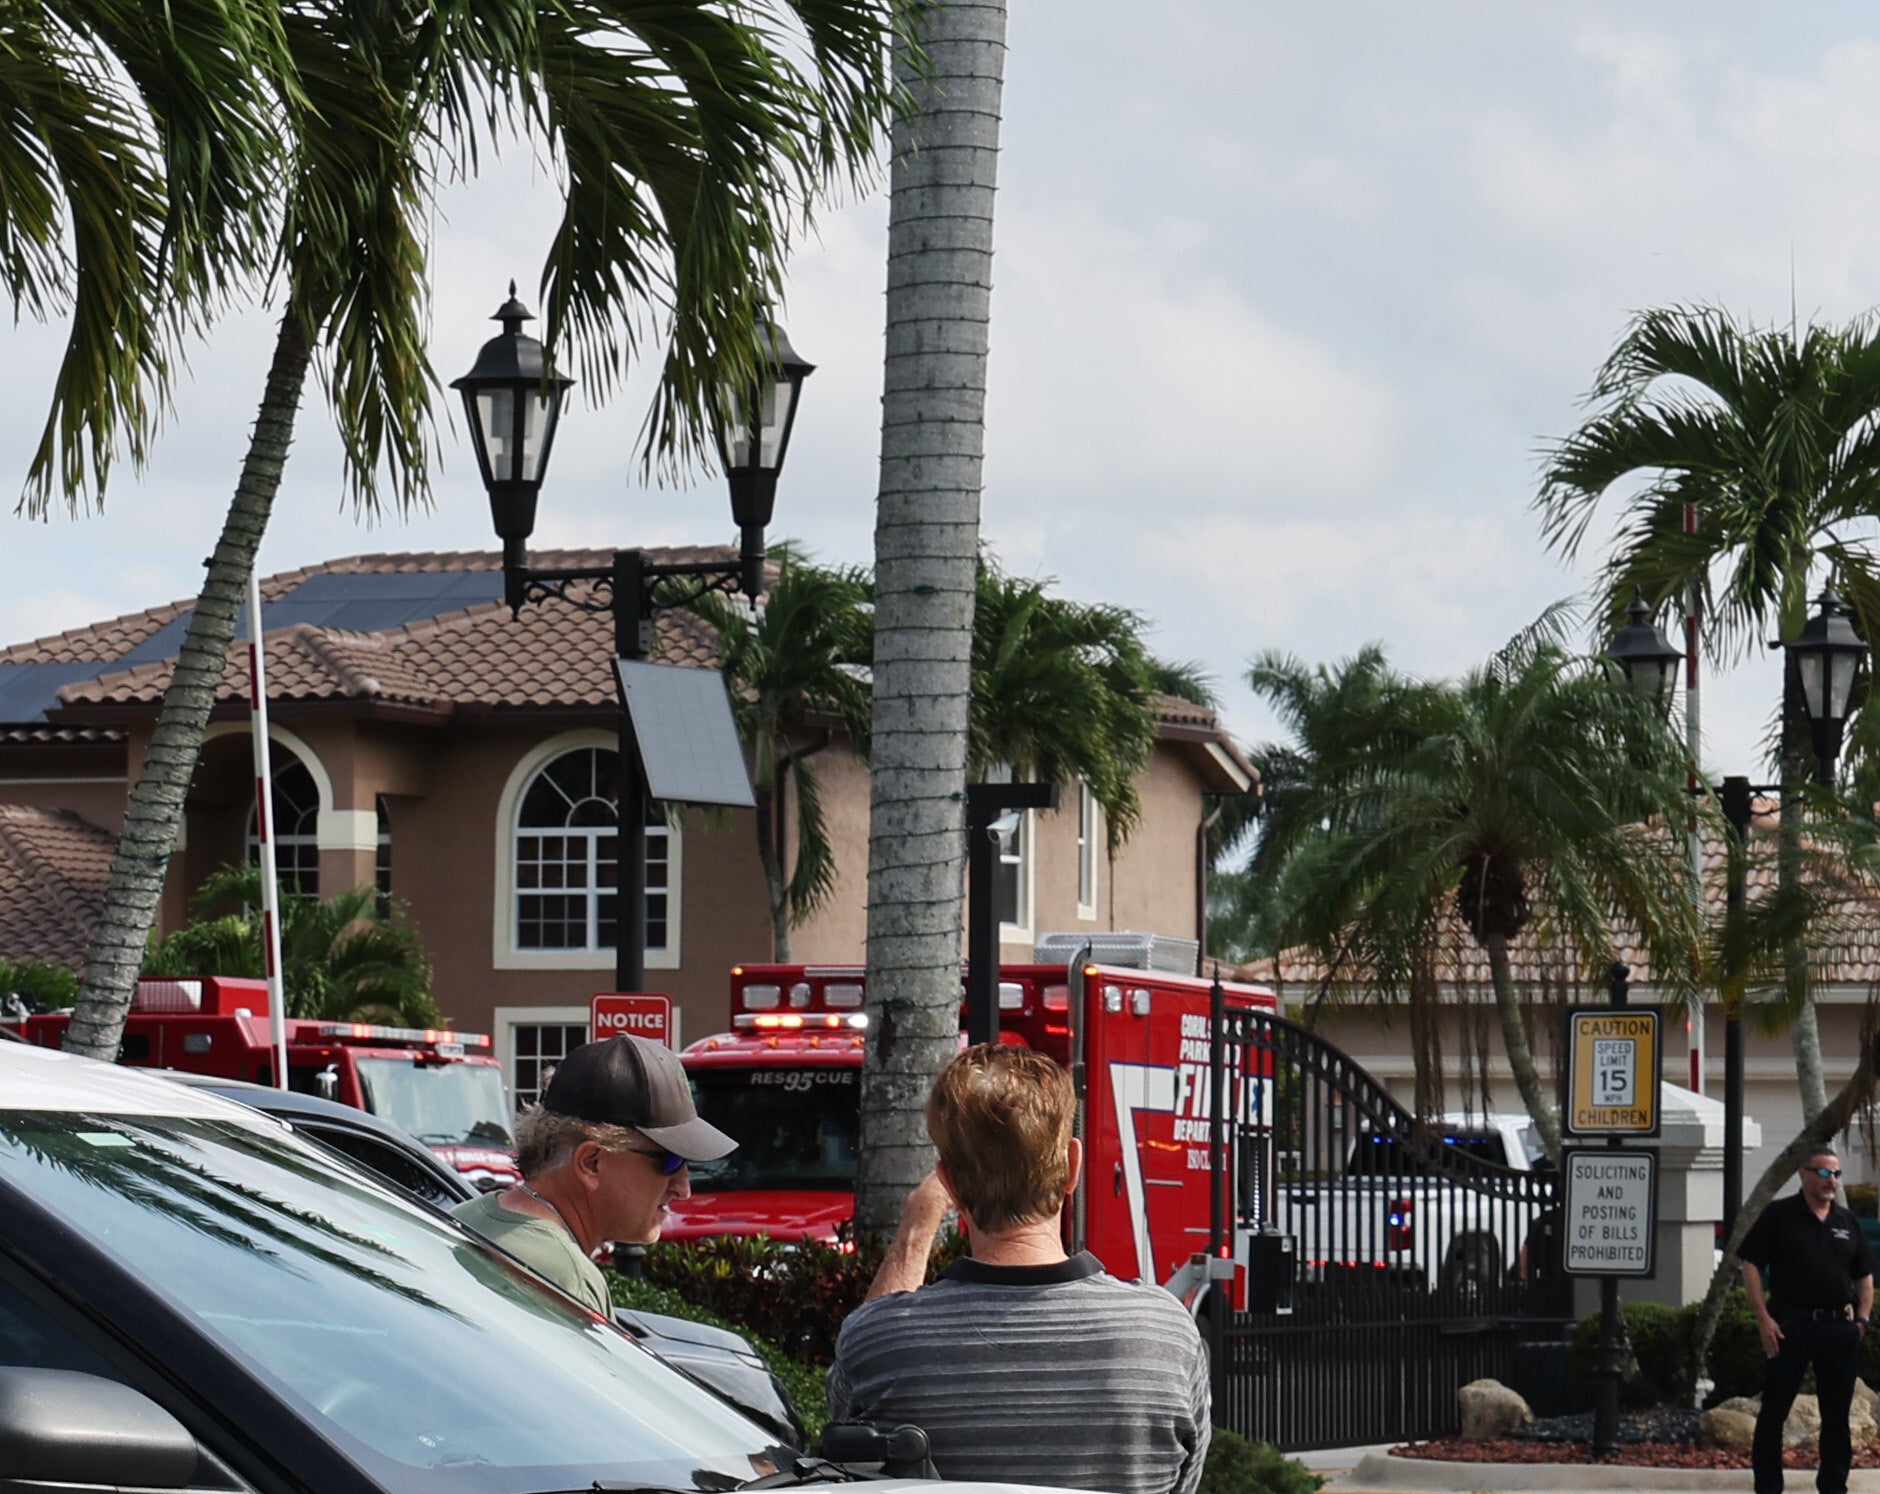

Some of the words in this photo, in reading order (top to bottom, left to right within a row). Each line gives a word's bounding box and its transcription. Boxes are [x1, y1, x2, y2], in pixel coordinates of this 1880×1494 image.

[597, 1013, 664, 1029] NOTICE
[1580, 1020, 1650, 1035] CAUTION
[1597, 1042, 1632, 1054] SPEED
[1600, 1055, 1627, 1066] LIMIT
[1600, 1070, 1628, 1091] 15
[1604, 1094, 1623, 1103] MPH
[1578, 1109, 1648, 1125] CHILDREN
[1575, 1165, 1646, 1180] SOLICITING
[1597, 1186, 1624, 1200] AND
[1582, 1205, 1636, 1220] POSTING
[1579, 1225, 1595, 1240] OF
[1602, 1226, 1638, 1240] BILLS
[1570, 1245, 1644, 1261] PROHIBITED
